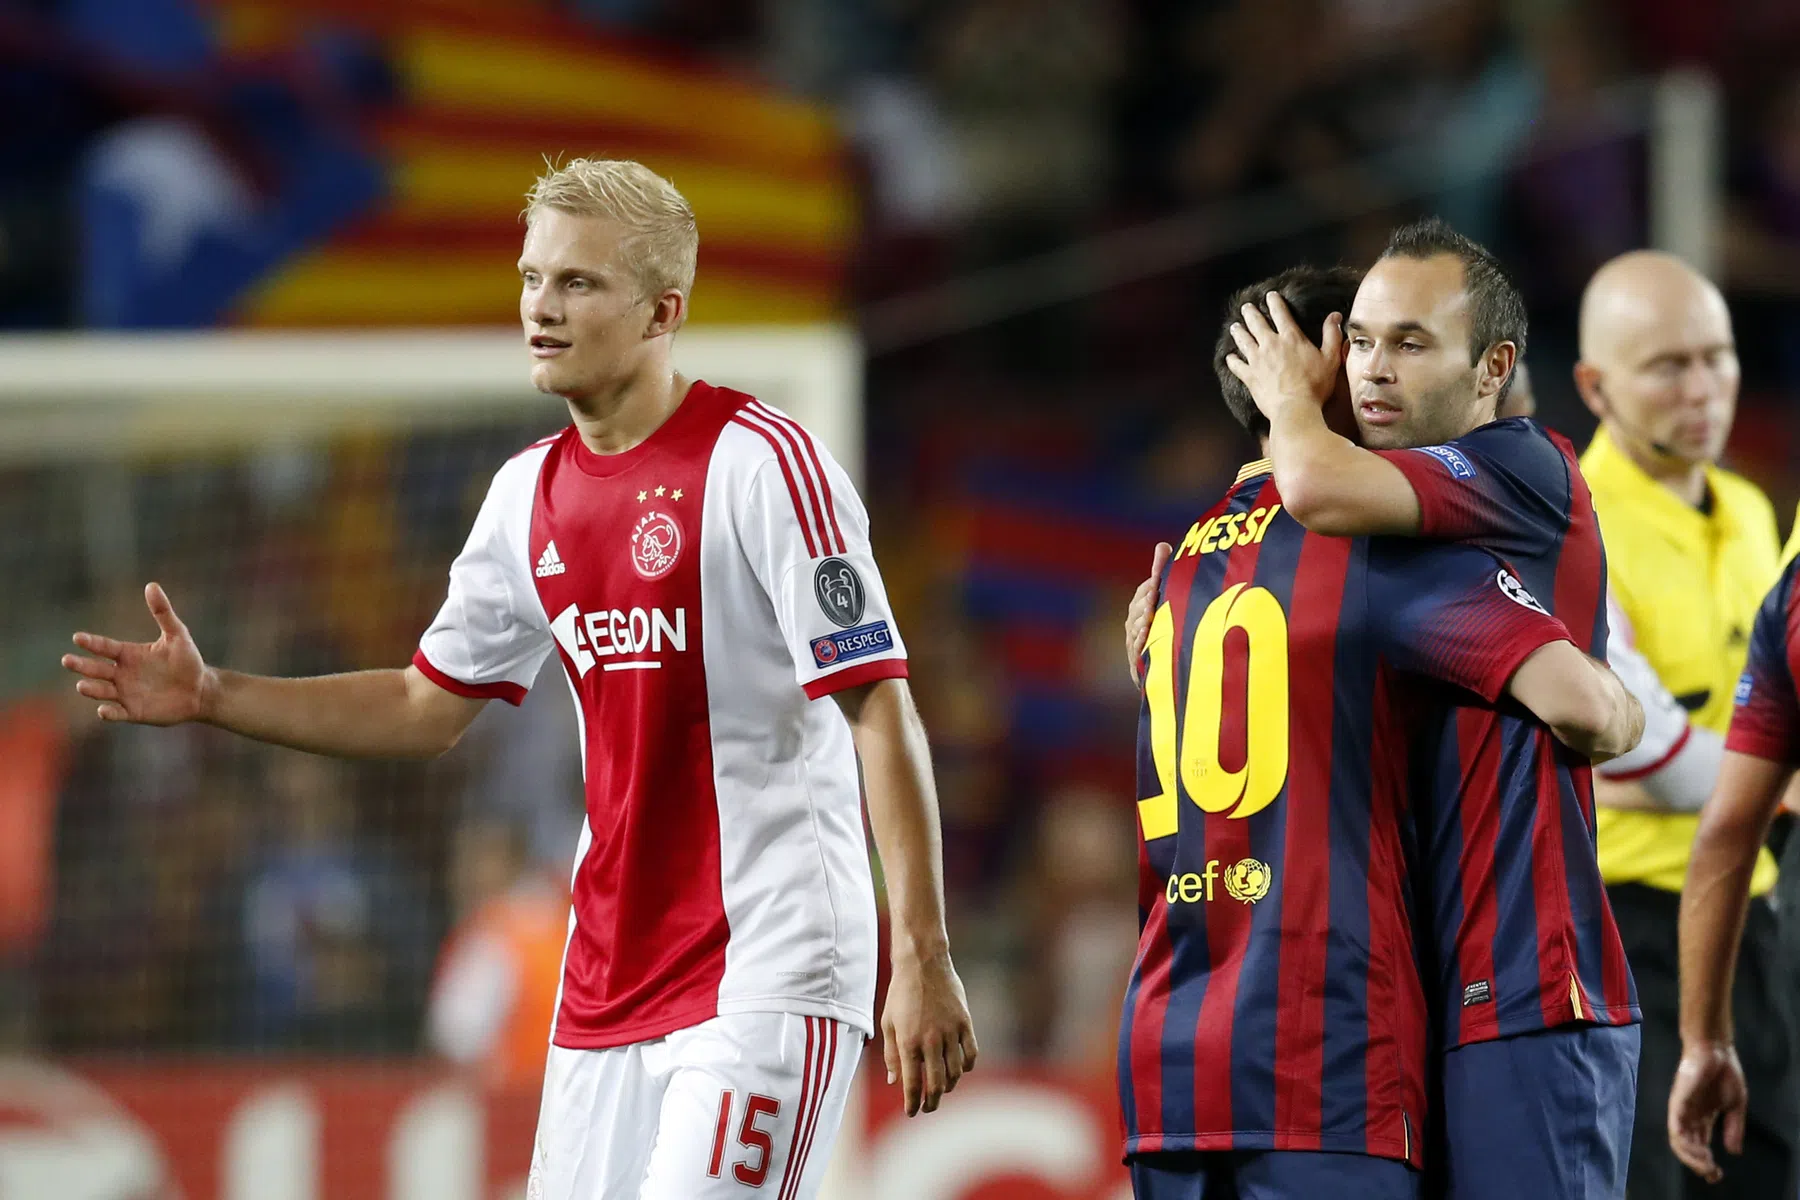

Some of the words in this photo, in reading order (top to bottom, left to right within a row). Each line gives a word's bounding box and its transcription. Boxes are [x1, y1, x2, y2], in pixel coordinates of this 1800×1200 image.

[631, 511, 656, 544] AJAX
[1173, 504, 1282, 562] MESSI
[536, 562, 566, 578] adidas
[836, 592, 849, 608] 4
[549, 602, 687, 680] AEGON
[837, 628, 890, 653] RESPECT
[1136, 582, 1289, 842] 10
[706, 1088, 782, 1188] 15
